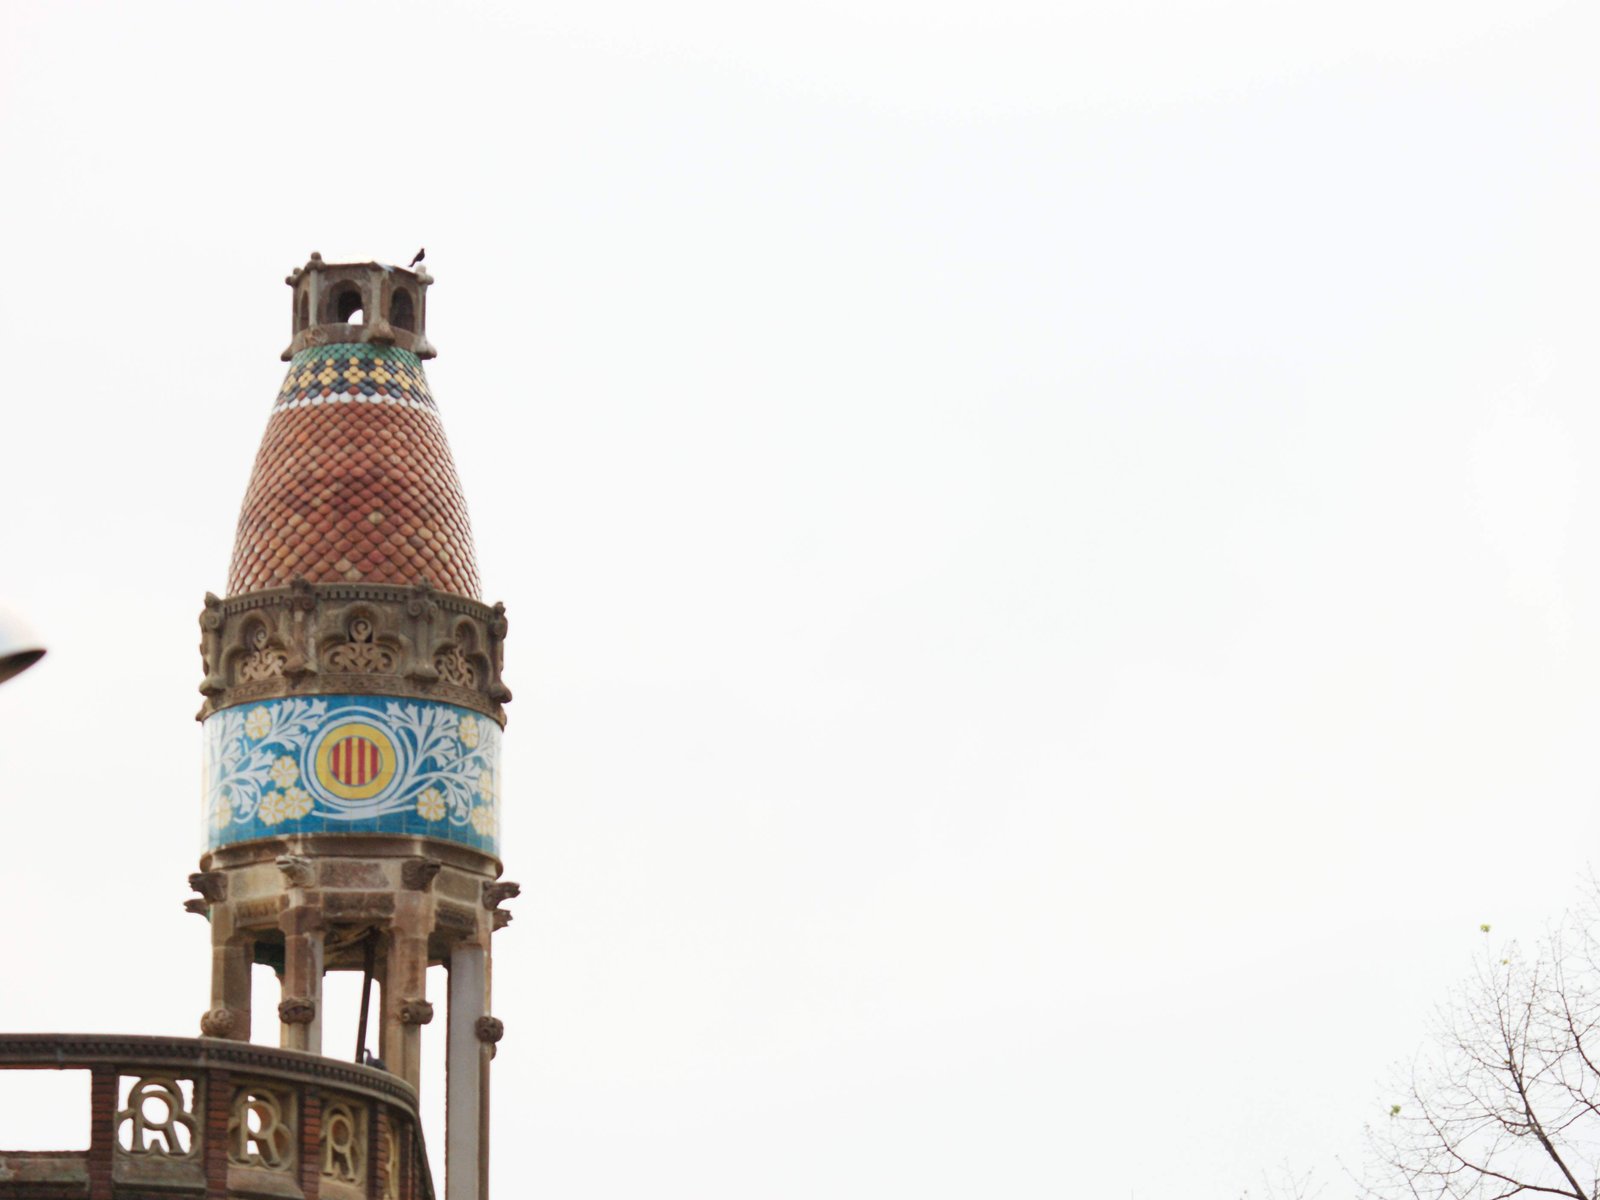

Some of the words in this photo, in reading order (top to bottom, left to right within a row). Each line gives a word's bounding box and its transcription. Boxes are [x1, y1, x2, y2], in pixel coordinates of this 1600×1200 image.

[131, 1089, 187, 1154] R
[238, 1100, 282, 1167] R
[324, 1113, 357, 1182] R
